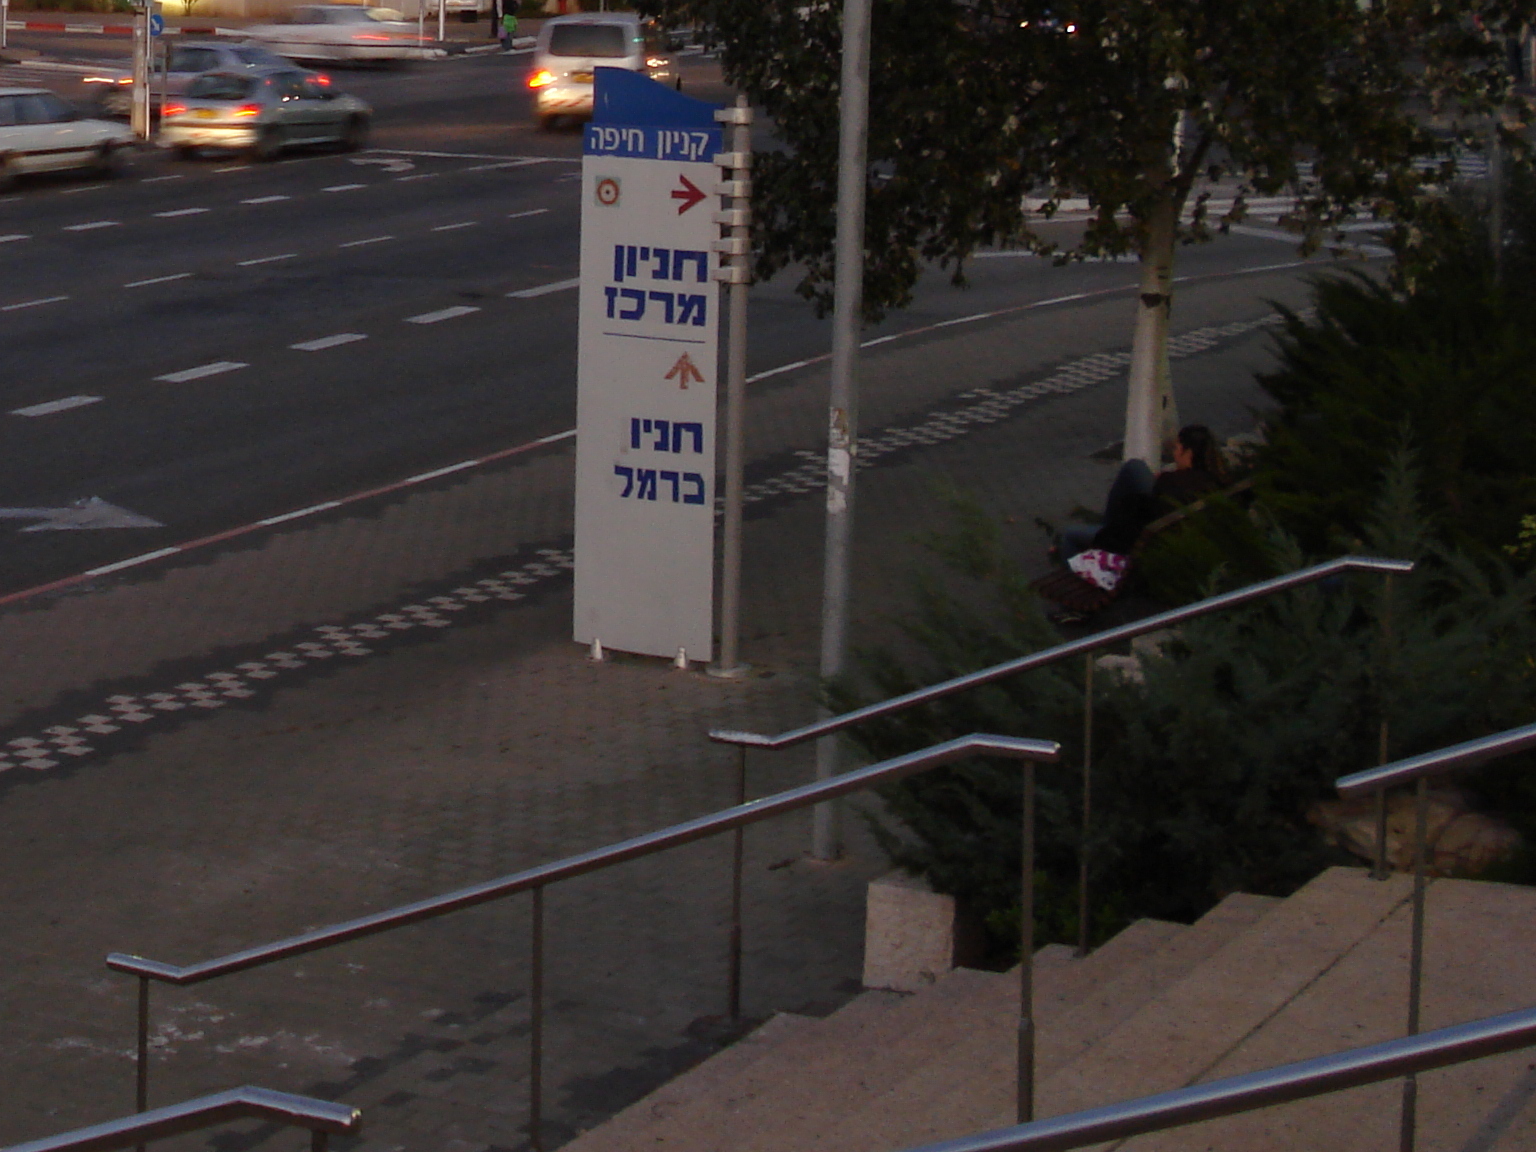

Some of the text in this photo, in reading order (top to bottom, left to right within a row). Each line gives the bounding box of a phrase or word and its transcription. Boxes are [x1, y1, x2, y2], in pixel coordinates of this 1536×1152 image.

[591, 126, 710, 161] קניון חיפה
[614, 244, 708, 283] חניון
[605, 286, 707, 327] מרכז
[614, 464, 705, 505] כרמל
